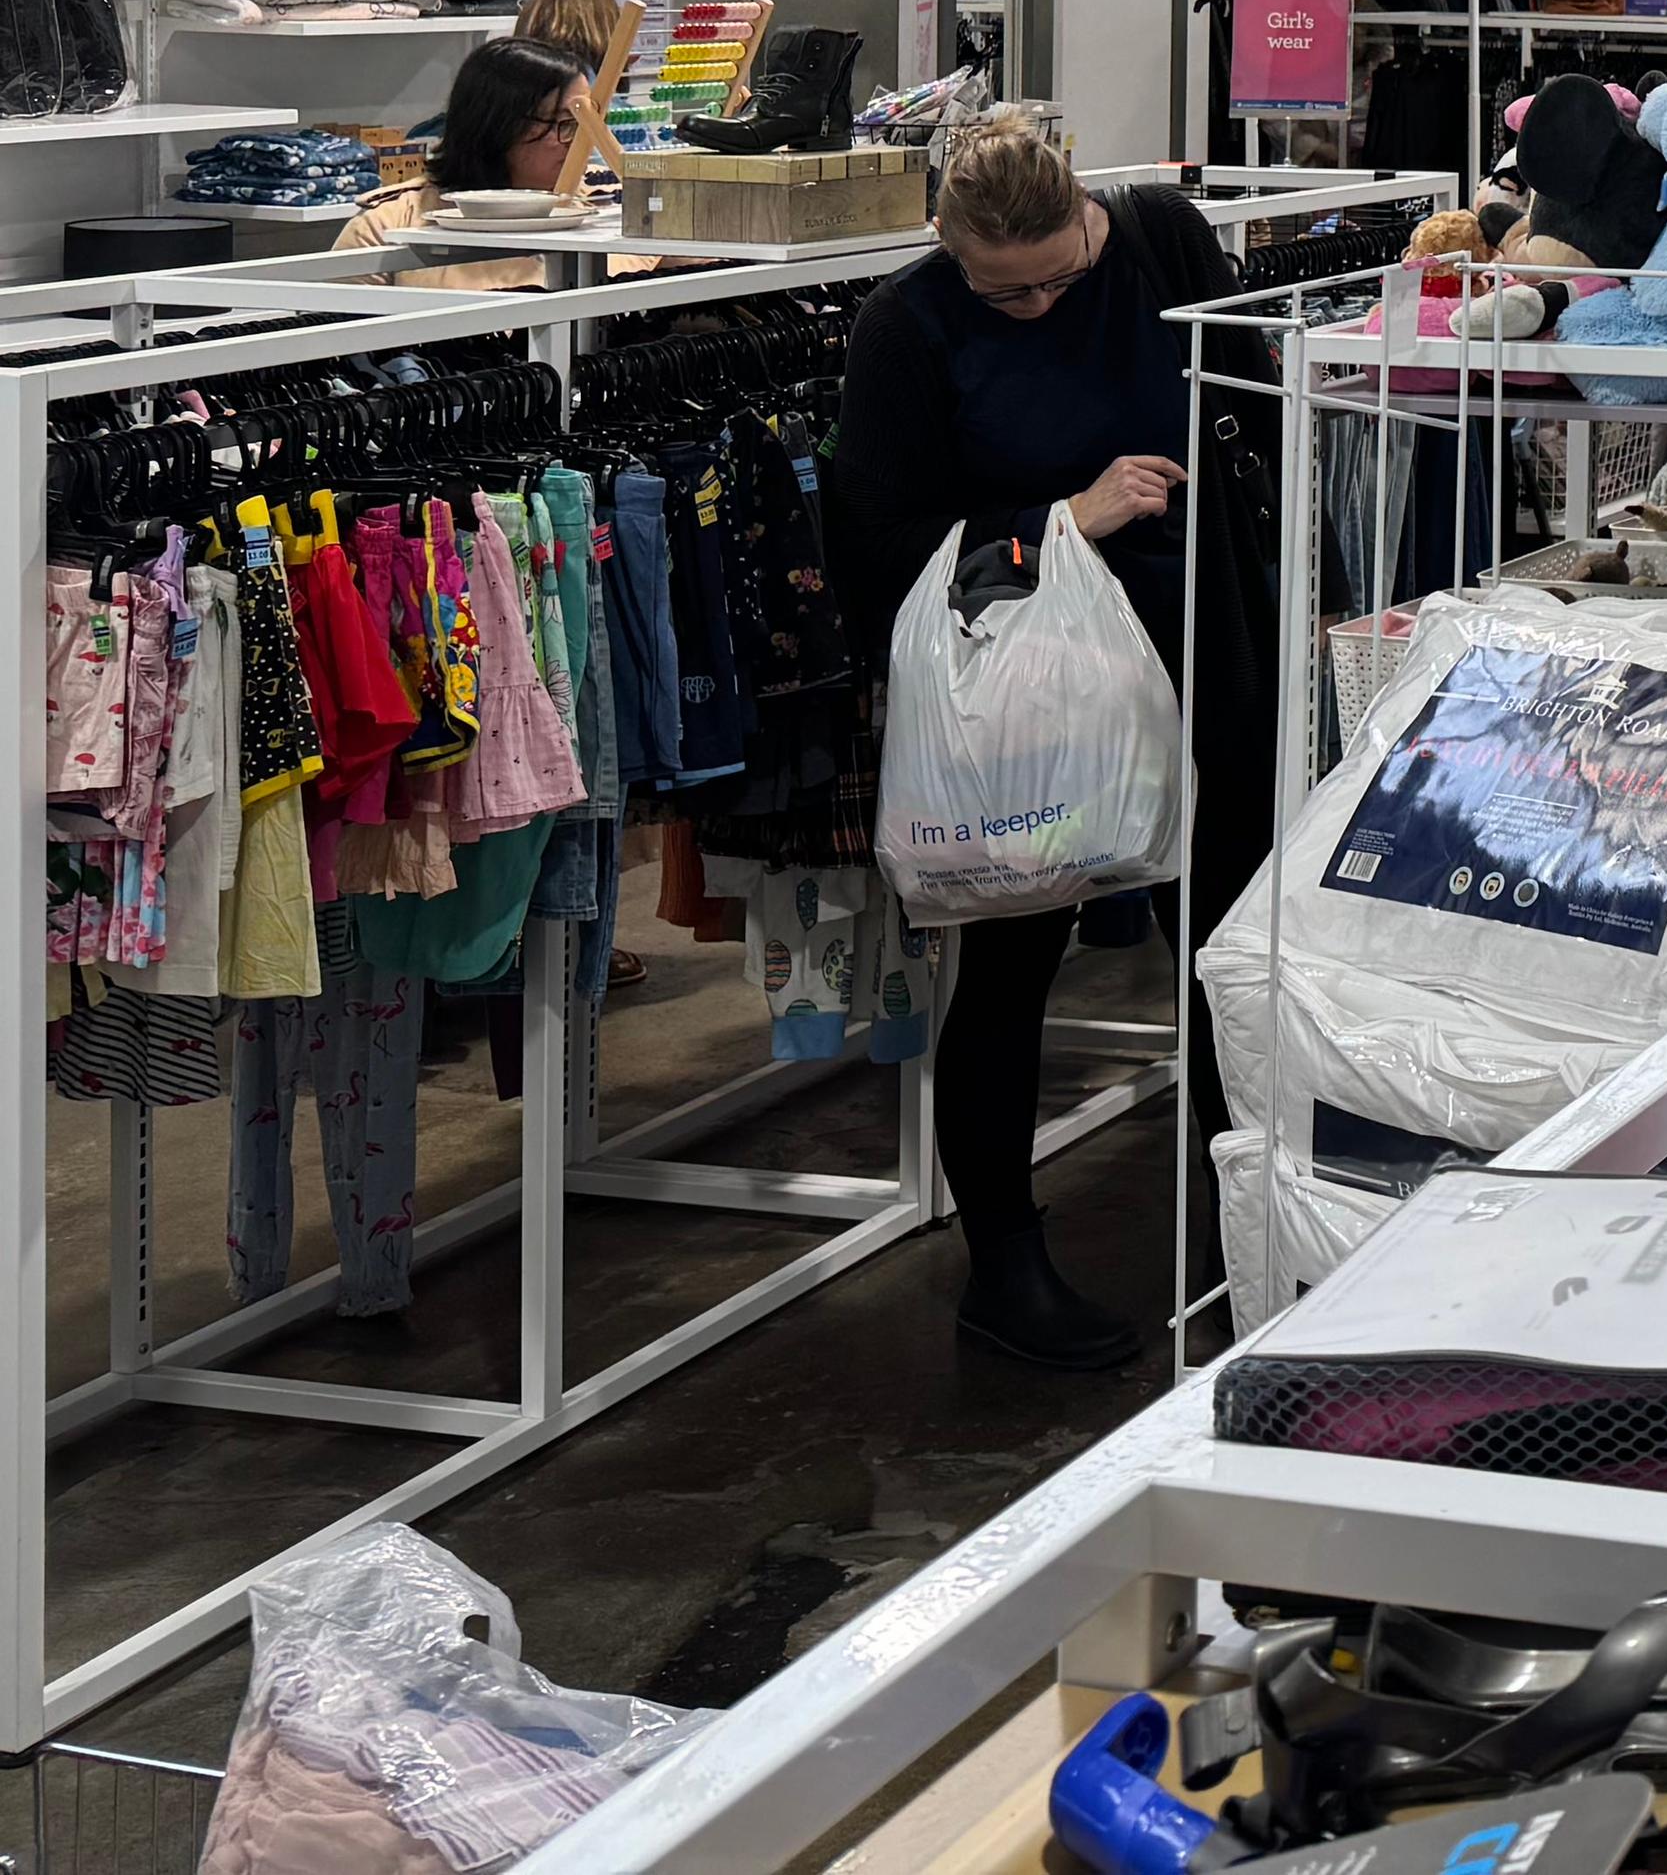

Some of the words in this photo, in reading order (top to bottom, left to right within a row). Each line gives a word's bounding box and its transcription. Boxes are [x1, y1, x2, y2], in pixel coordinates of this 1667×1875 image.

[1267, 11, 1314, 29] Girl's
[1267, 36, 1313, 49] wear
[1499, 696, 1612, 727] BRIGHTON
[911, 820, 946, 845] I'm
[955, 825, 972, 842] a
[981, 802, 1071, 837] keeper.
